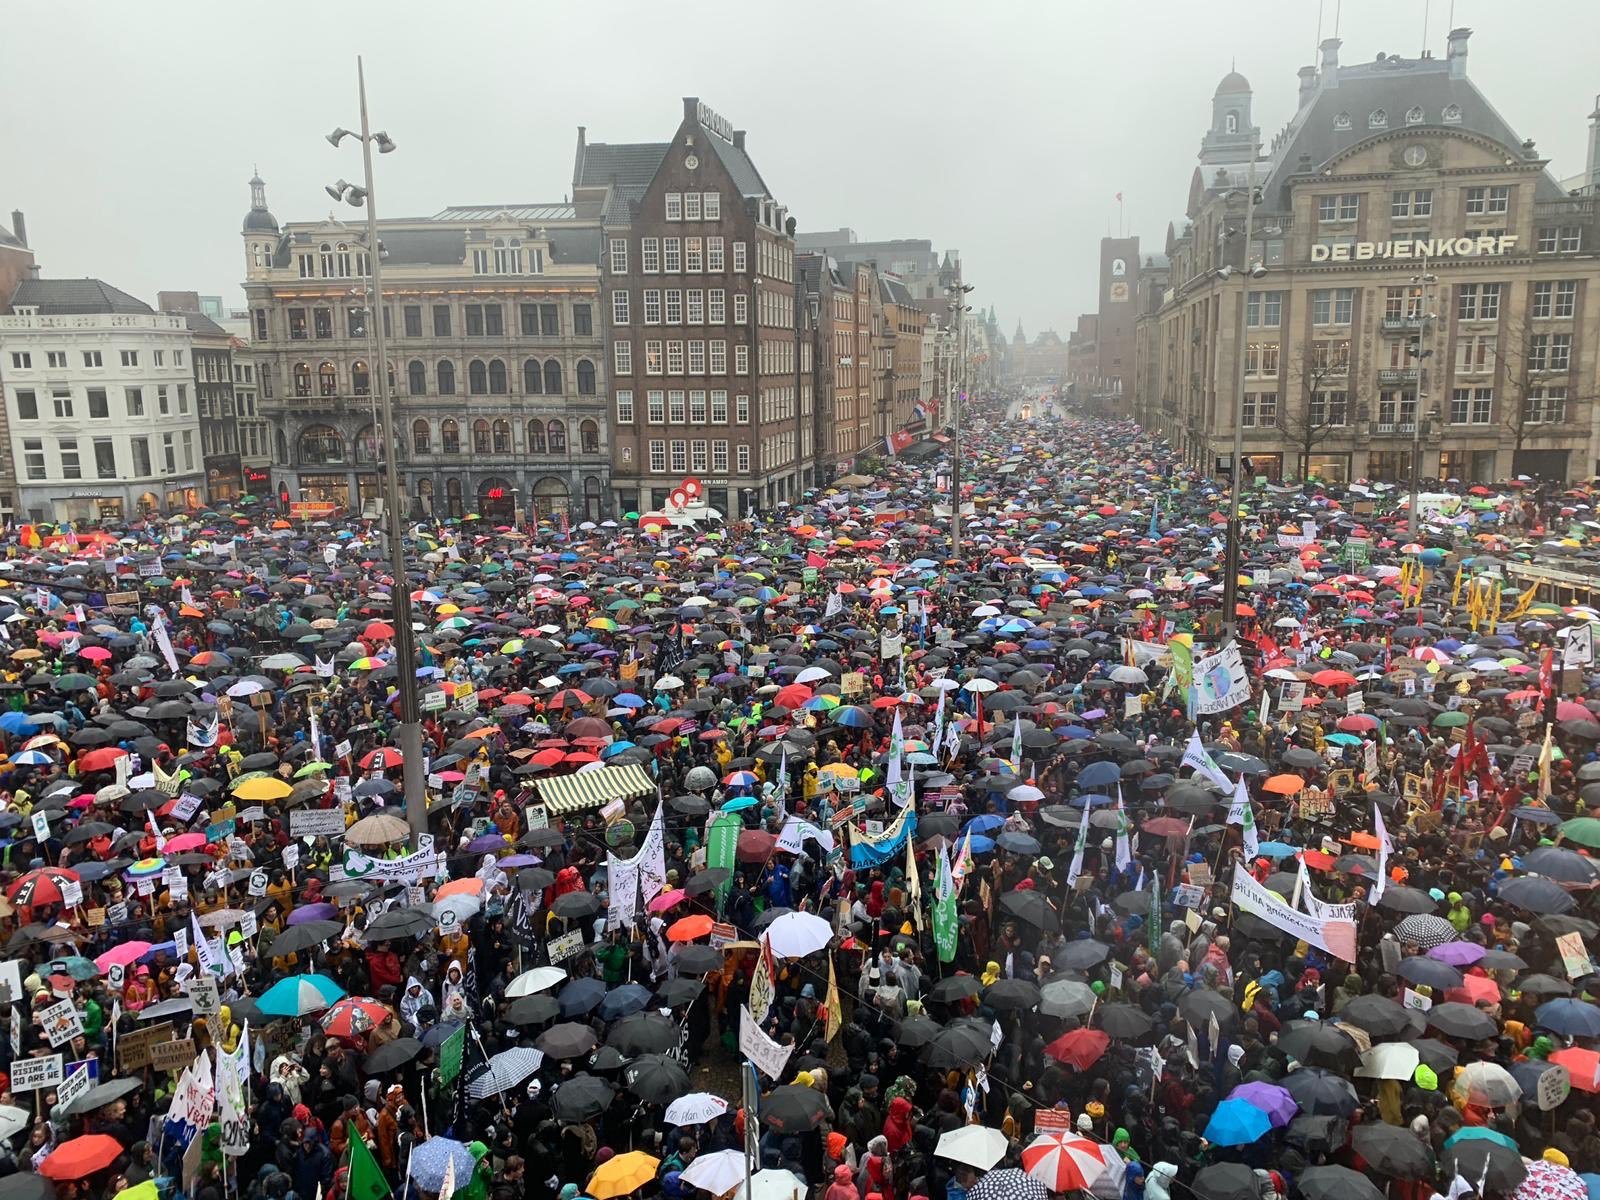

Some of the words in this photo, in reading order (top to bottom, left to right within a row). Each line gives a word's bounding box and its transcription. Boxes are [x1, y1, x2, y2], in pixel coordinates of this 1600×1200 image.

[1311, 243, 1350, 262] DE
[1356, 235, 1519, 260] BIJENKORF
[407, 849, 431, 863] voor
[43, 1007, 72, 1024] GETTING
[63, 1026, 80, 1039] HERE
[23, 1059, 44, 1067] OCEANS
[12, 1065, 43, 1077] RISING
[13, 1076, 25, 1086] SO
[27, 1073, 45, 1083] ARE
[47, 1070, 60, 1079] WE
[60, 1093, 70, 1105] JE
[70, 1077, 87, 1097] DOEN
